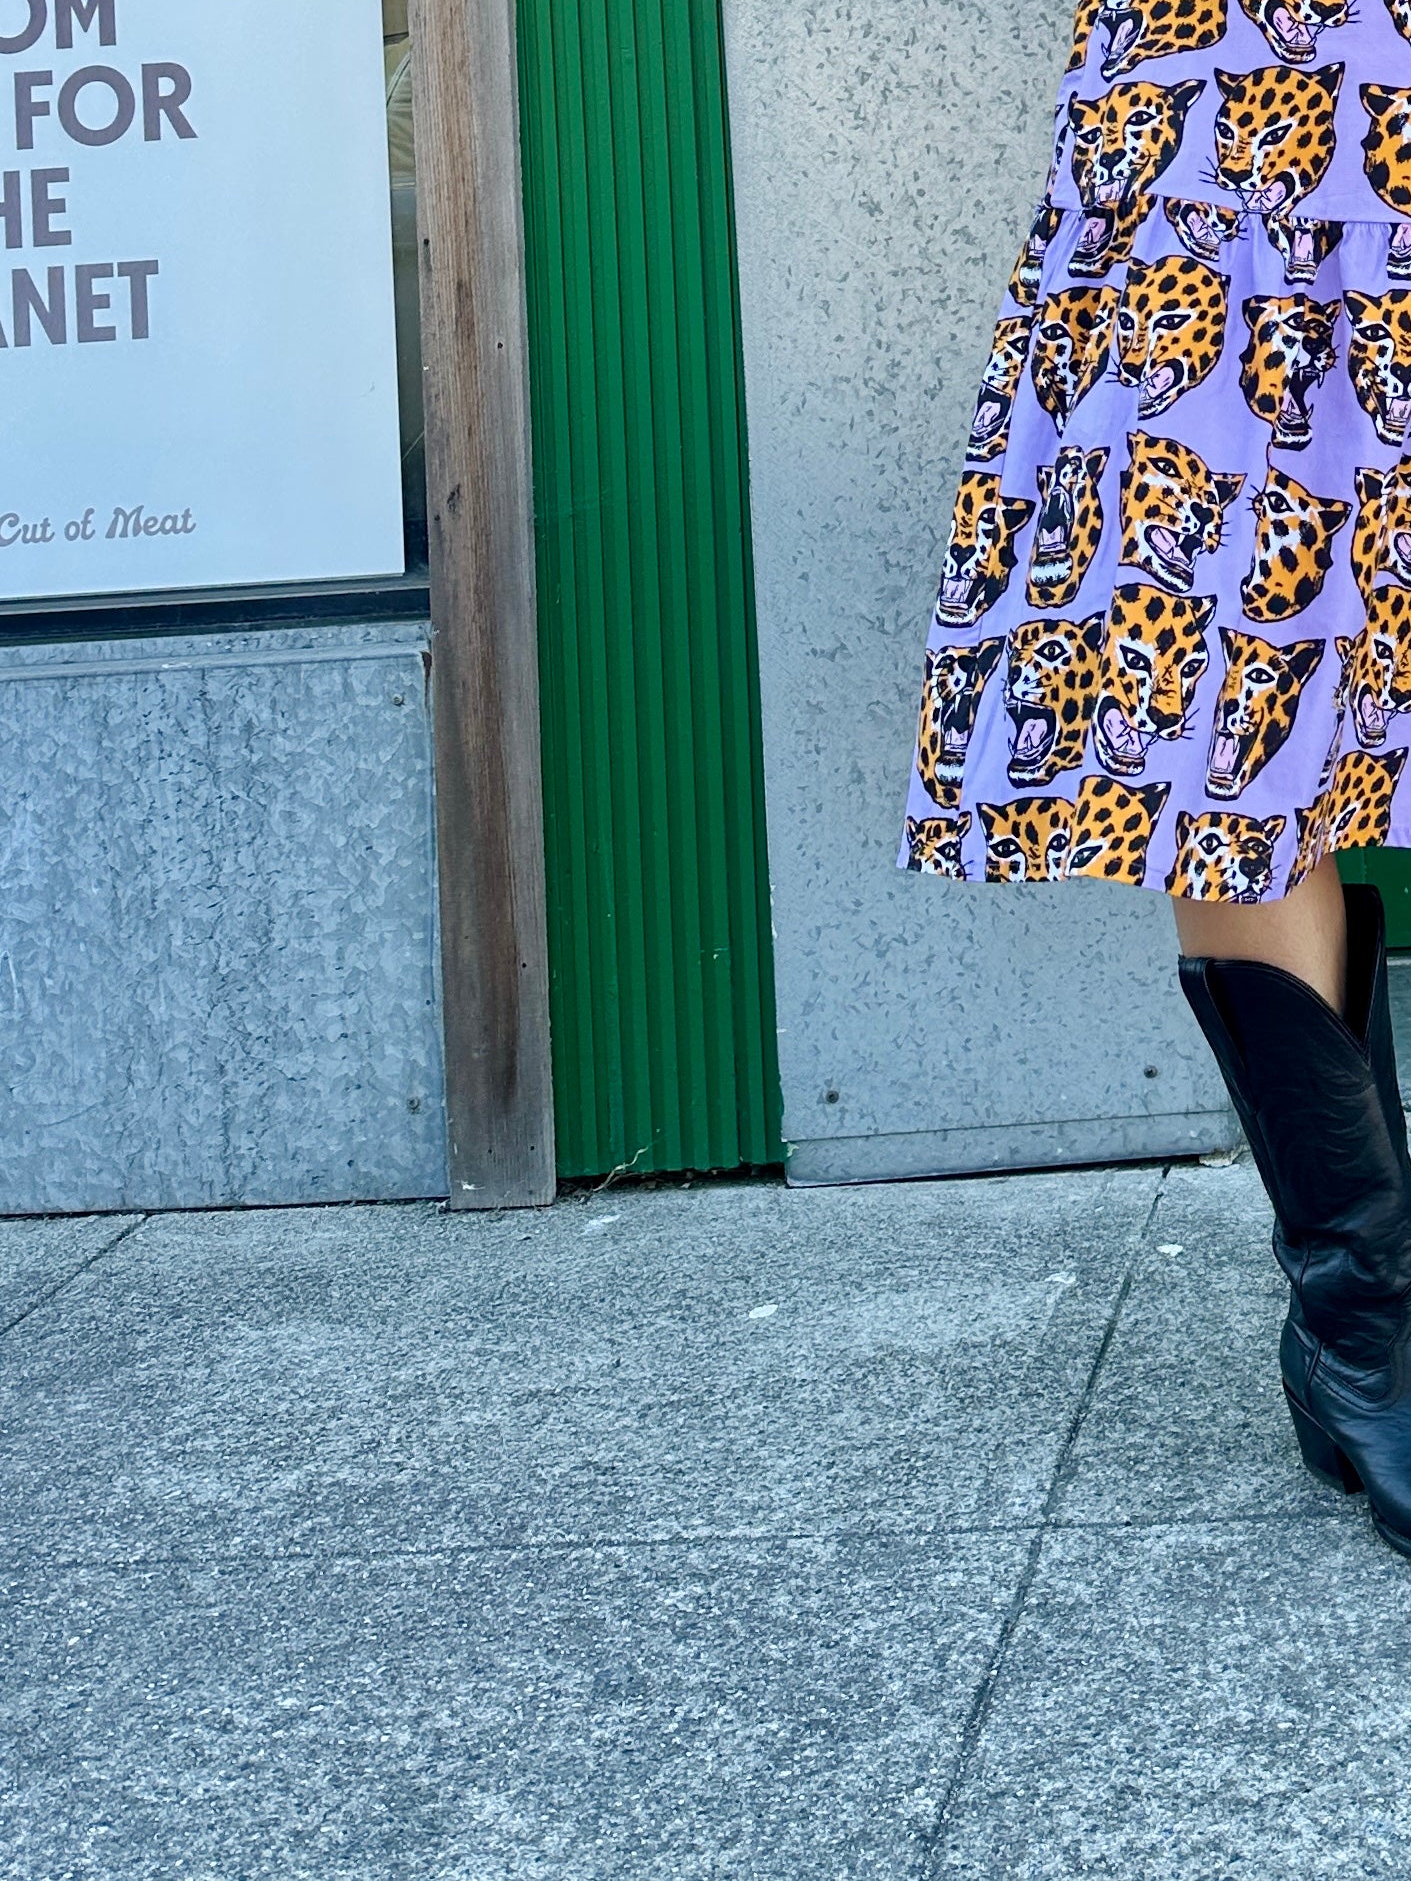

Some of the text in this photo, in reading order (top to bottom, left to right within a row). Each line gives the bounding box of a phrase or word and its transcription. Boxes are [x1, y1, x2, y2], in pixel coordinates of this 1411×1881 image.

[14, 61, 199, 150] FOR
[0, 259, 159, 349] NET
[0, 504, 197, 548] Cut of Meat
